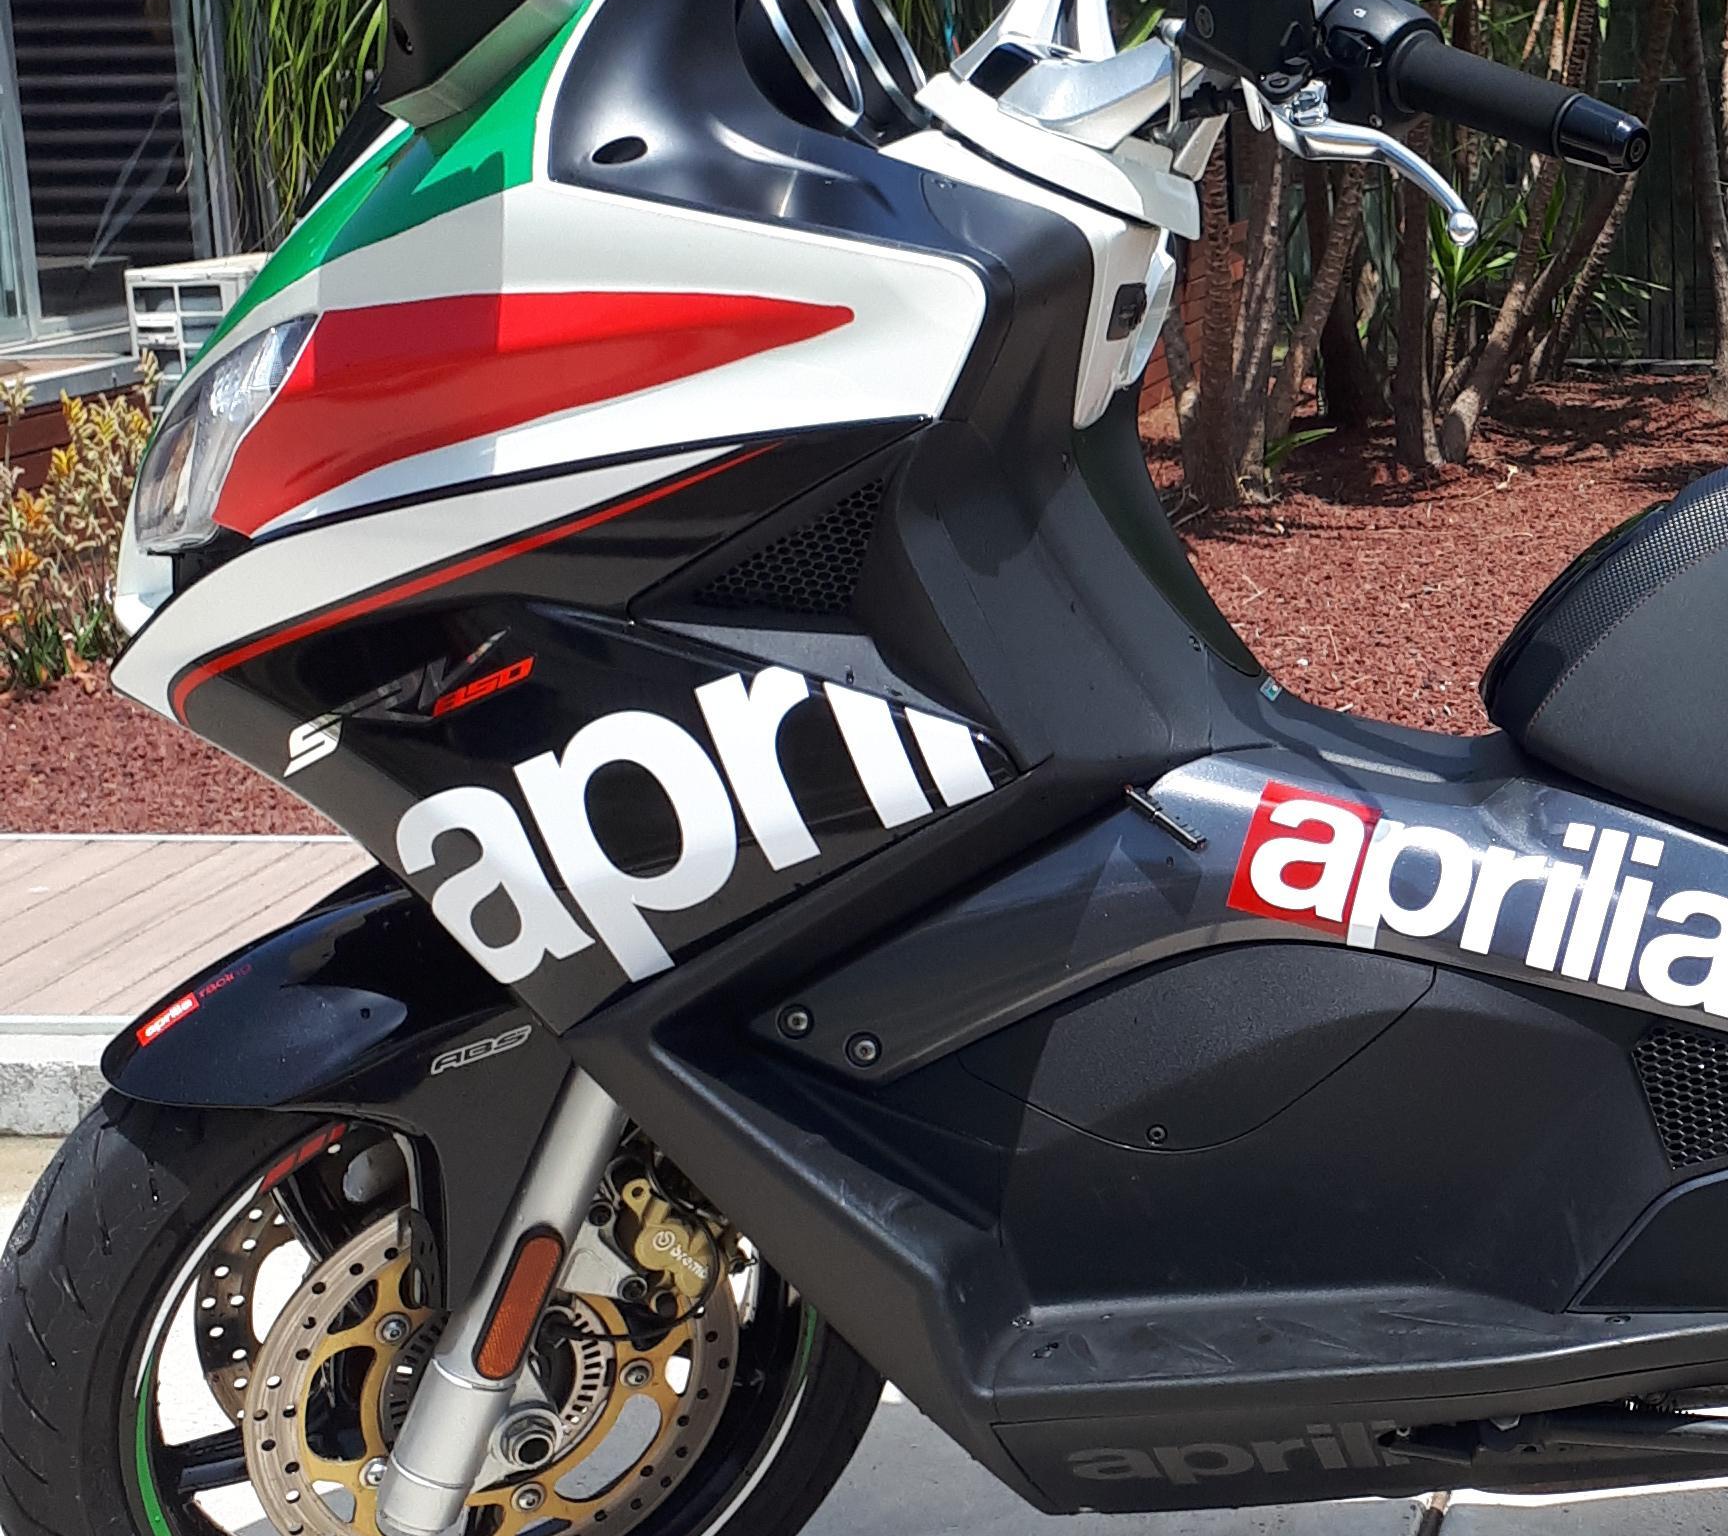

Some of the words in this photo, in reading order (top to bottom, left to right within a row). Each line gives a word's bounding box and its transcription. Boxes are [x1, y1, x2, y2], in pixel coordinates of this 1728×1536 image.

[282, 625, 512, 779] SRV
[431, 653, 537, 719] 850
[144, 997, 193, 1038] aprilia
[430, 1024, 532, 1076] ABS
[670, 1244, 709, 1280] bremb
